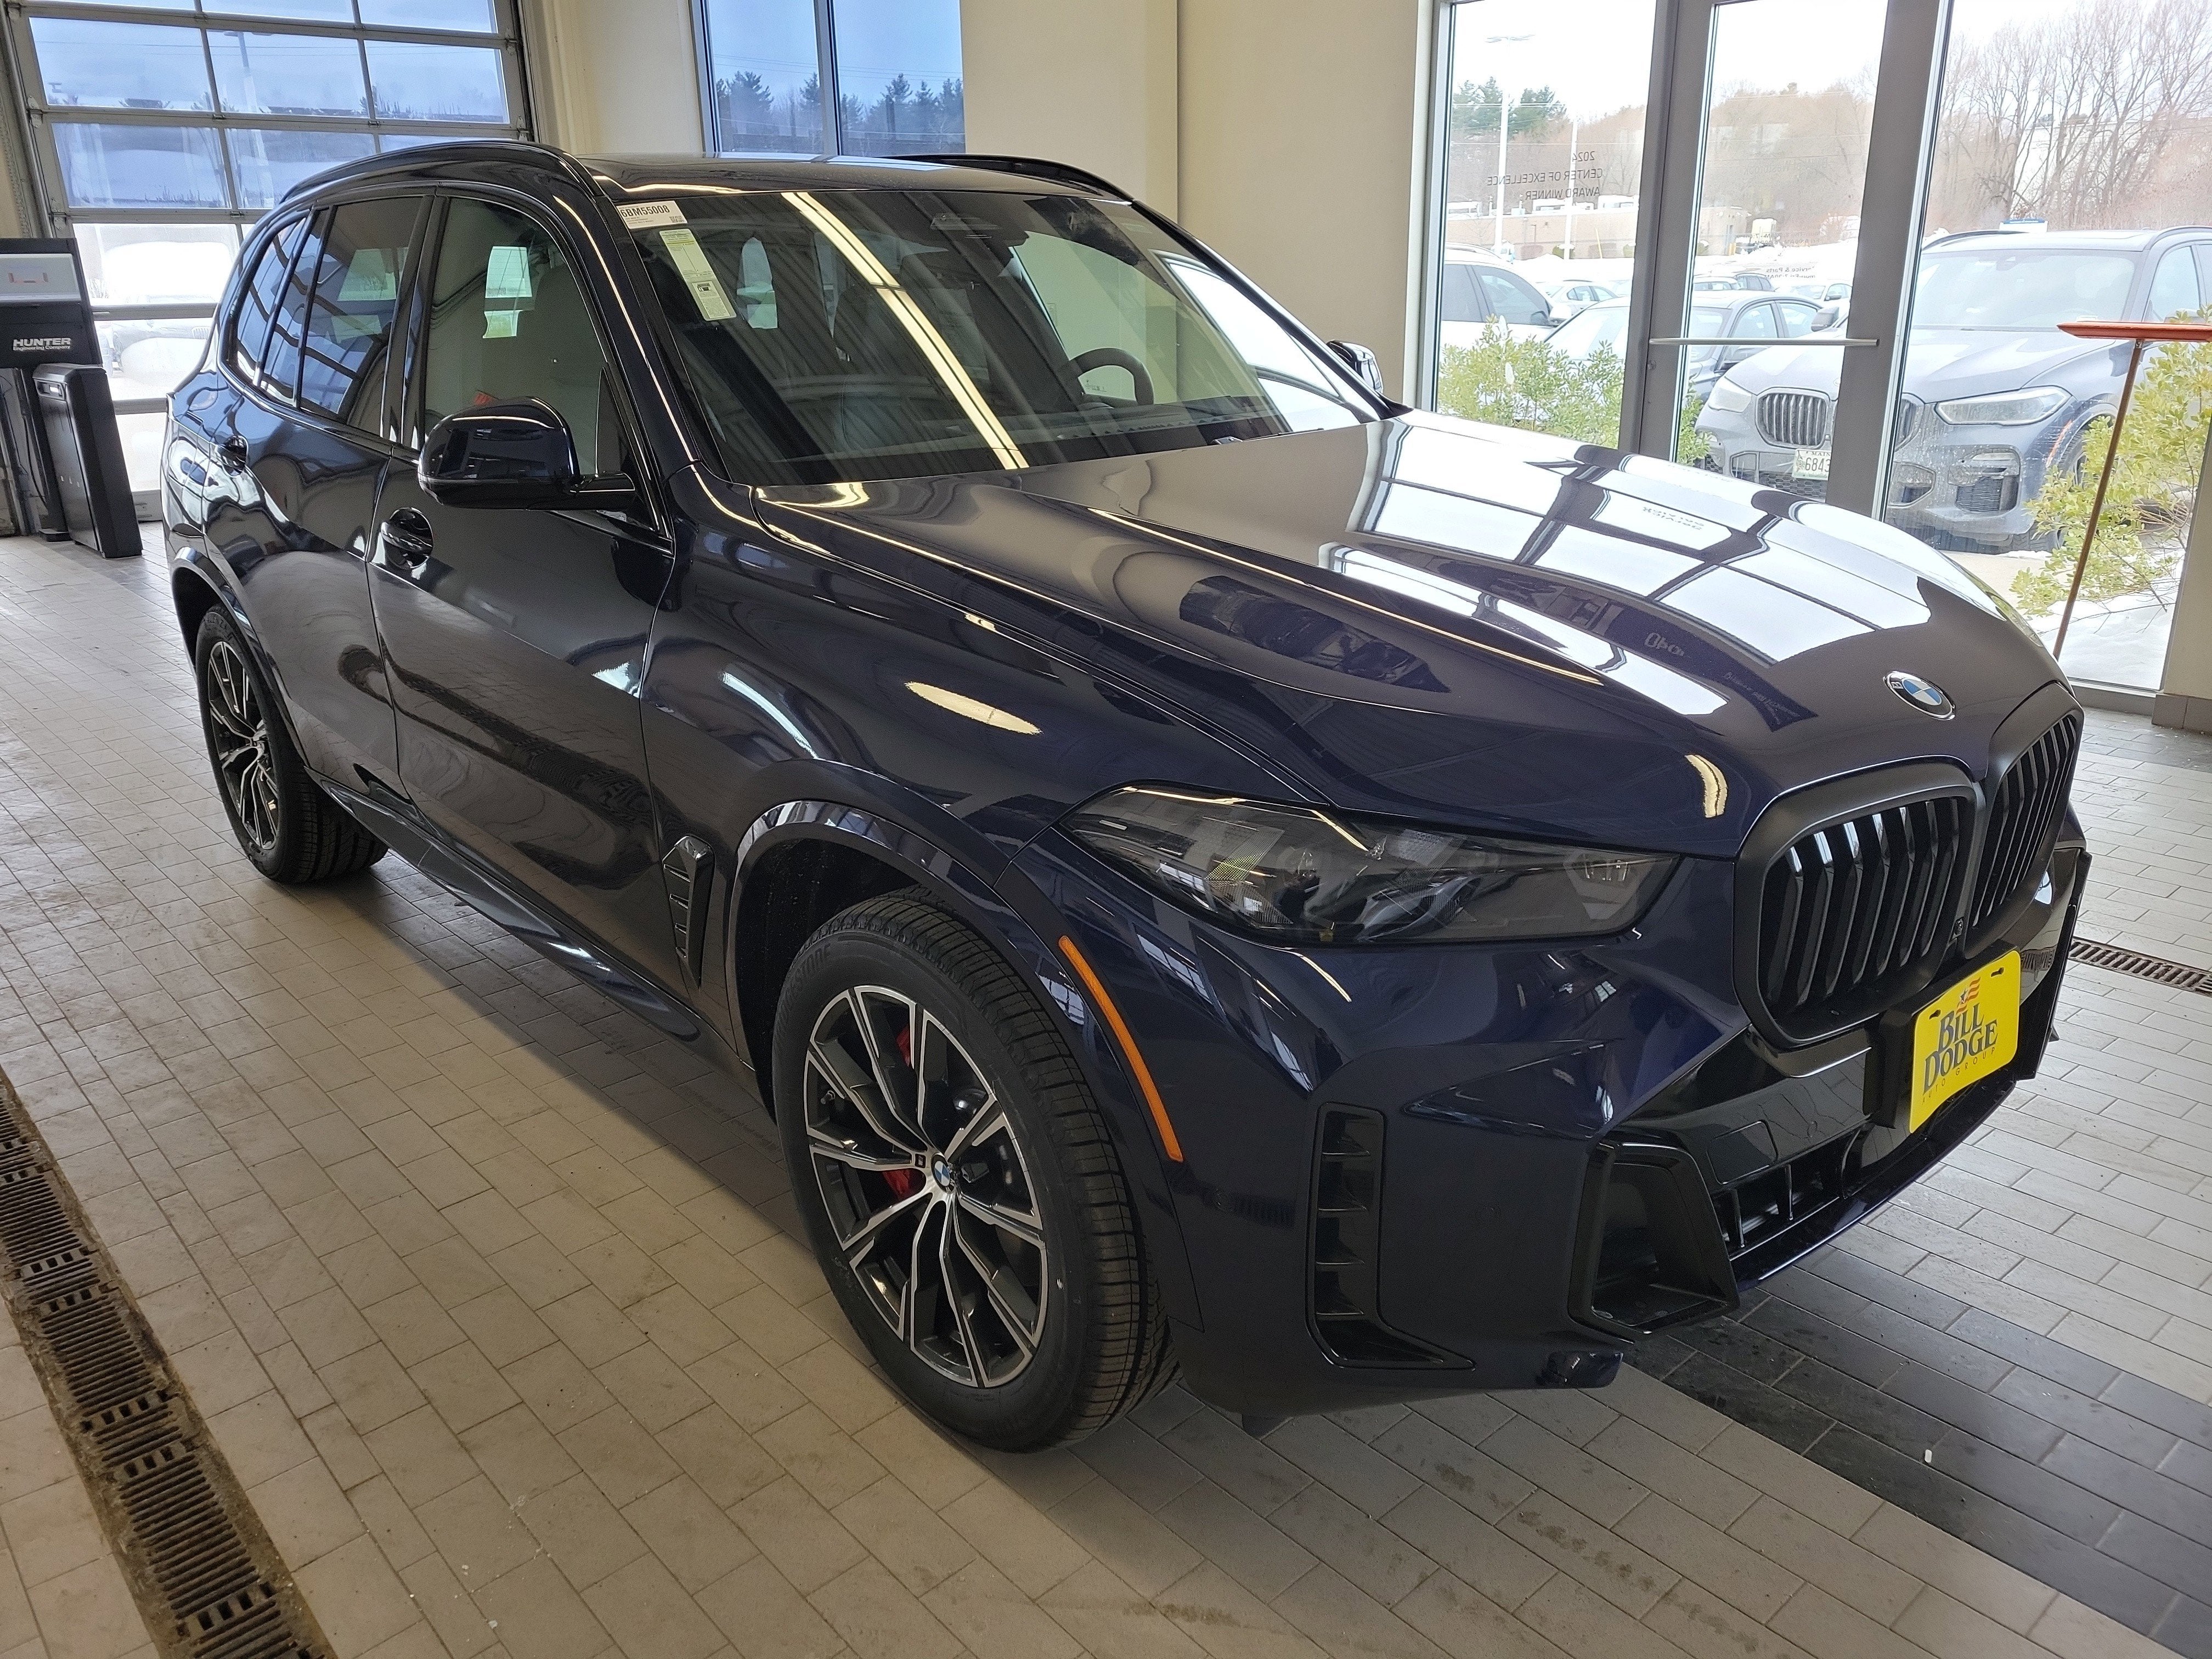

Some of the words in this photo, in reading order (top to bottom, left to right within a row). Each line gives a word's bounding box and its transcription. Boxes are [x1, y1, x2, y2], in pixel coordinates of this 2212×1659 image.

[620, 205, 670, 217] 6BM55008
[13, 337, 71, 346] HUNTER
[1938, 1002, 1984, 1052] BILL
[1922, 1078, 1946, 1105] AUTO
[1955, 1047, 1995, 1076] GROUP
[1923, 1019, 1999, 1096] DODGE
